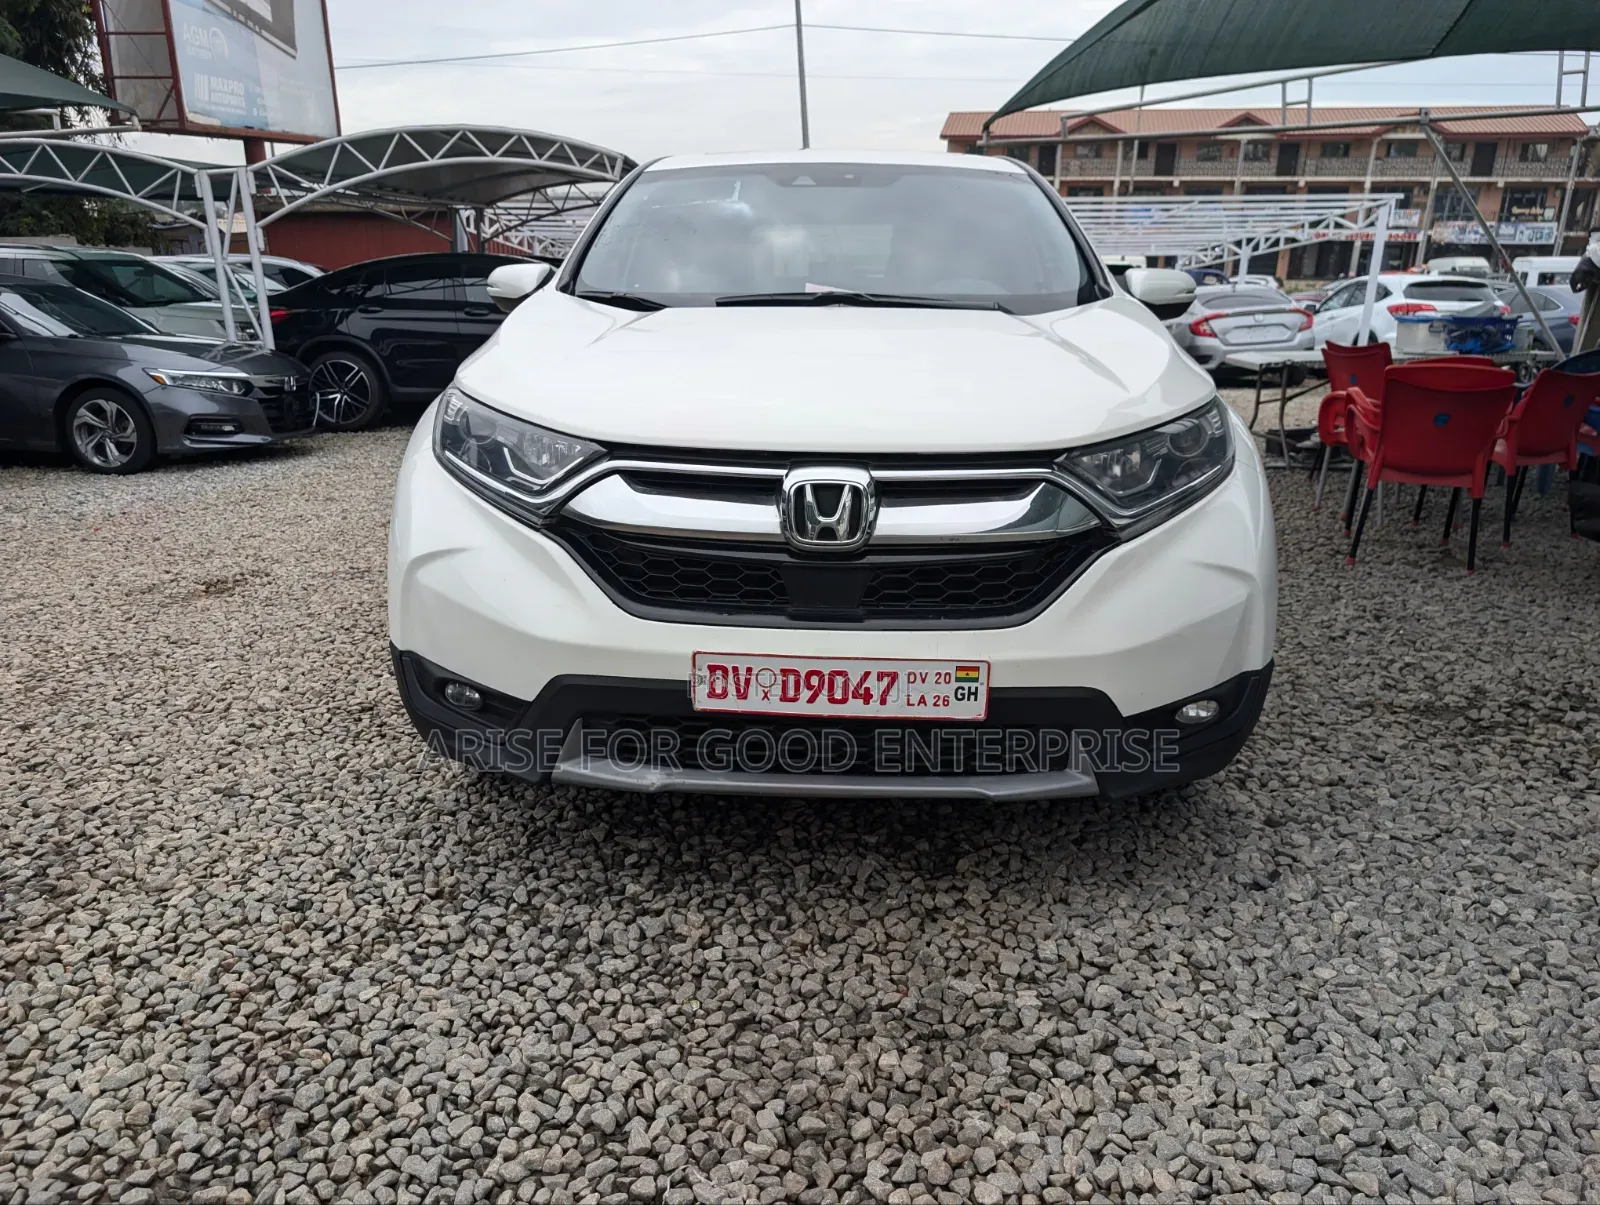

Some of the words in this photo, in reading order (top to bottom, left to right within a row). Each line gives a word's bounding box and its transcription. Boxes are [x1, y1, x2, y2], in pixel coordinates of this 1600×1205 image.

[183, 21, 210, 48] AGM
[210, 76, 245, 95] MAXPRO
[706, 664, 752, 700] DV
[906, 671, 929, 685] DV
[934, 672, 951, 685] 20
[905, 694, 928, 707] LA
[932, 694, 951, 707] 26
[954, 685, 979, 702] GH
